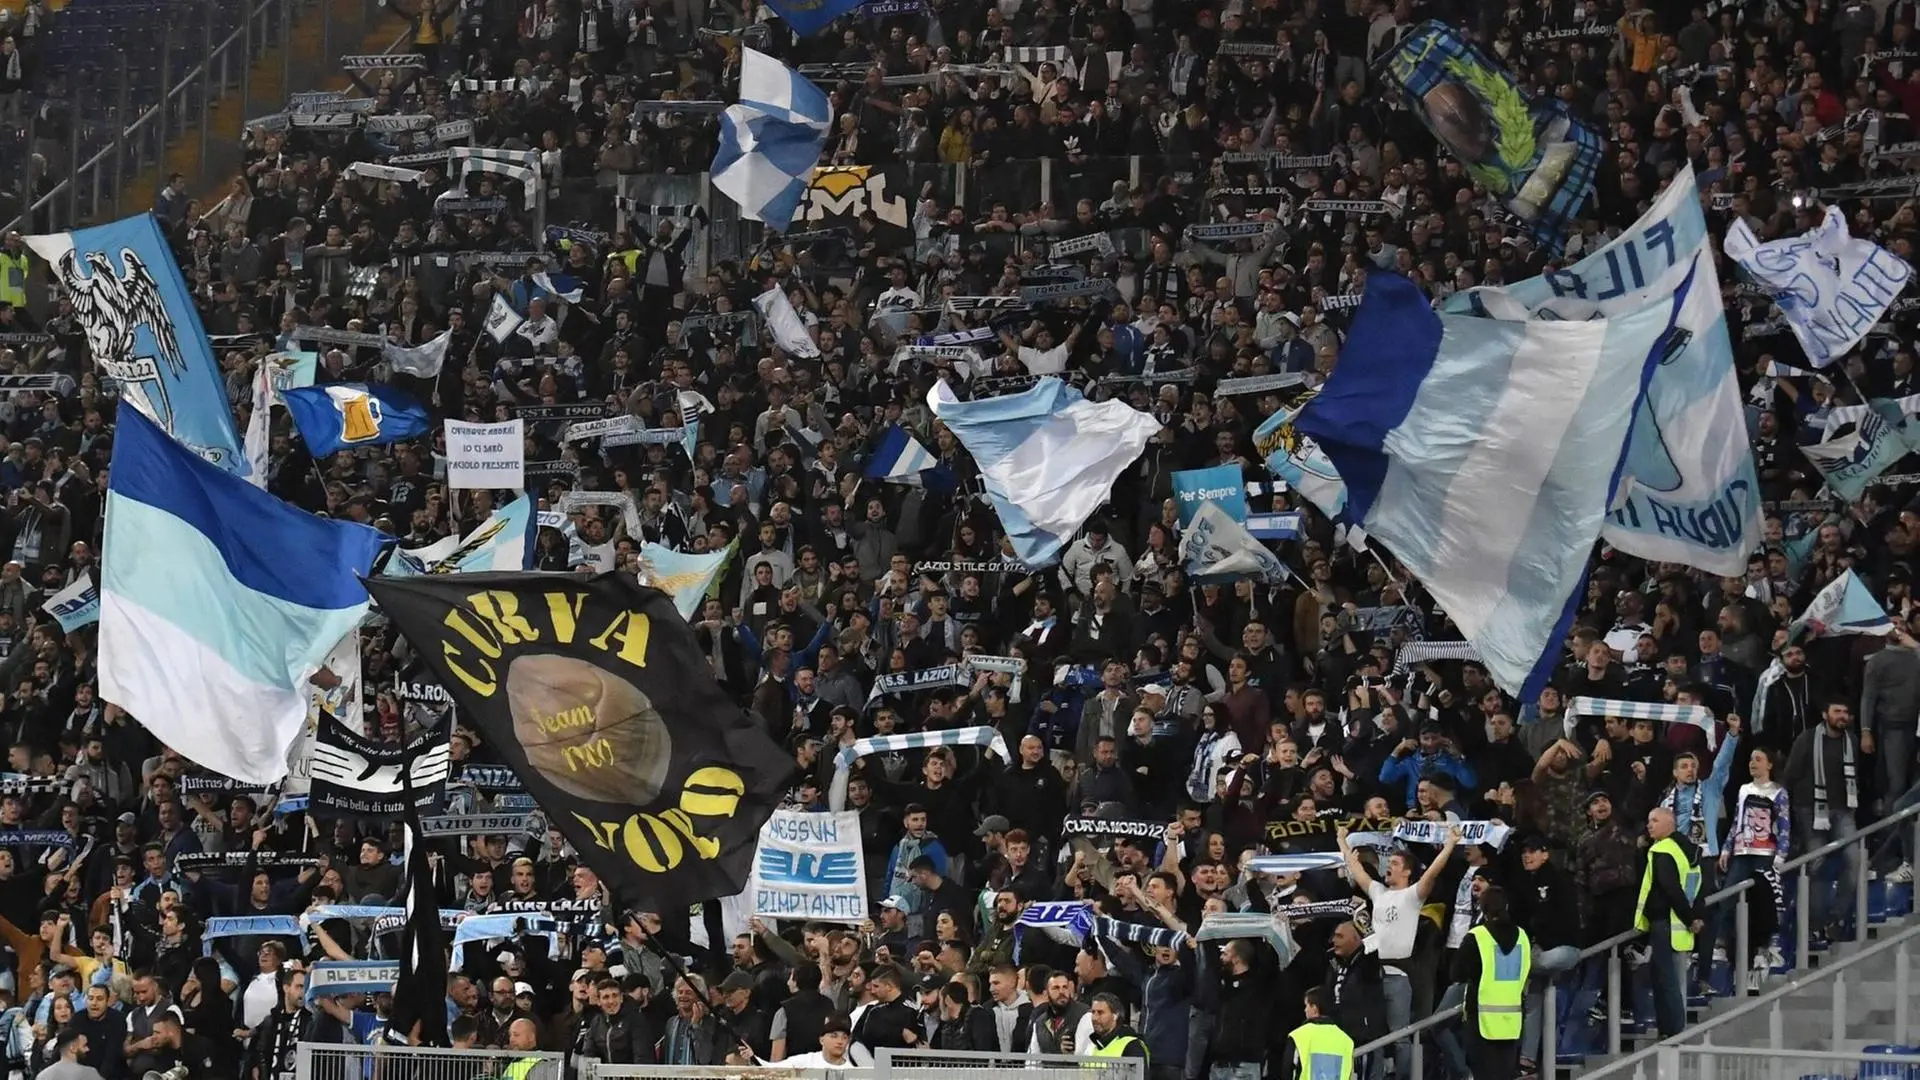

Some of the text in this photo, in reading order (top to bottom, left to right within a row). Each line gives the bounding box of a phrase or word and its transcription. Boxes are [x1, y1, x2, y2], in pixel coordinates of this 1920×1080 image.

[564, 406, 603, 415] 1900
[1197, 487, 1237, 501] Sempre
[953, 561, 987, 572] STILE
[441, 589, 650, 698] CURVA
[913, 668, 951, 684] LAZIO
[350, 798, 371, 812] bella
[372, 801, 383, 813] di
[422, 816, 522, 834] LAZIO 1900
[1459, 823, 1485, 840] AZIO
